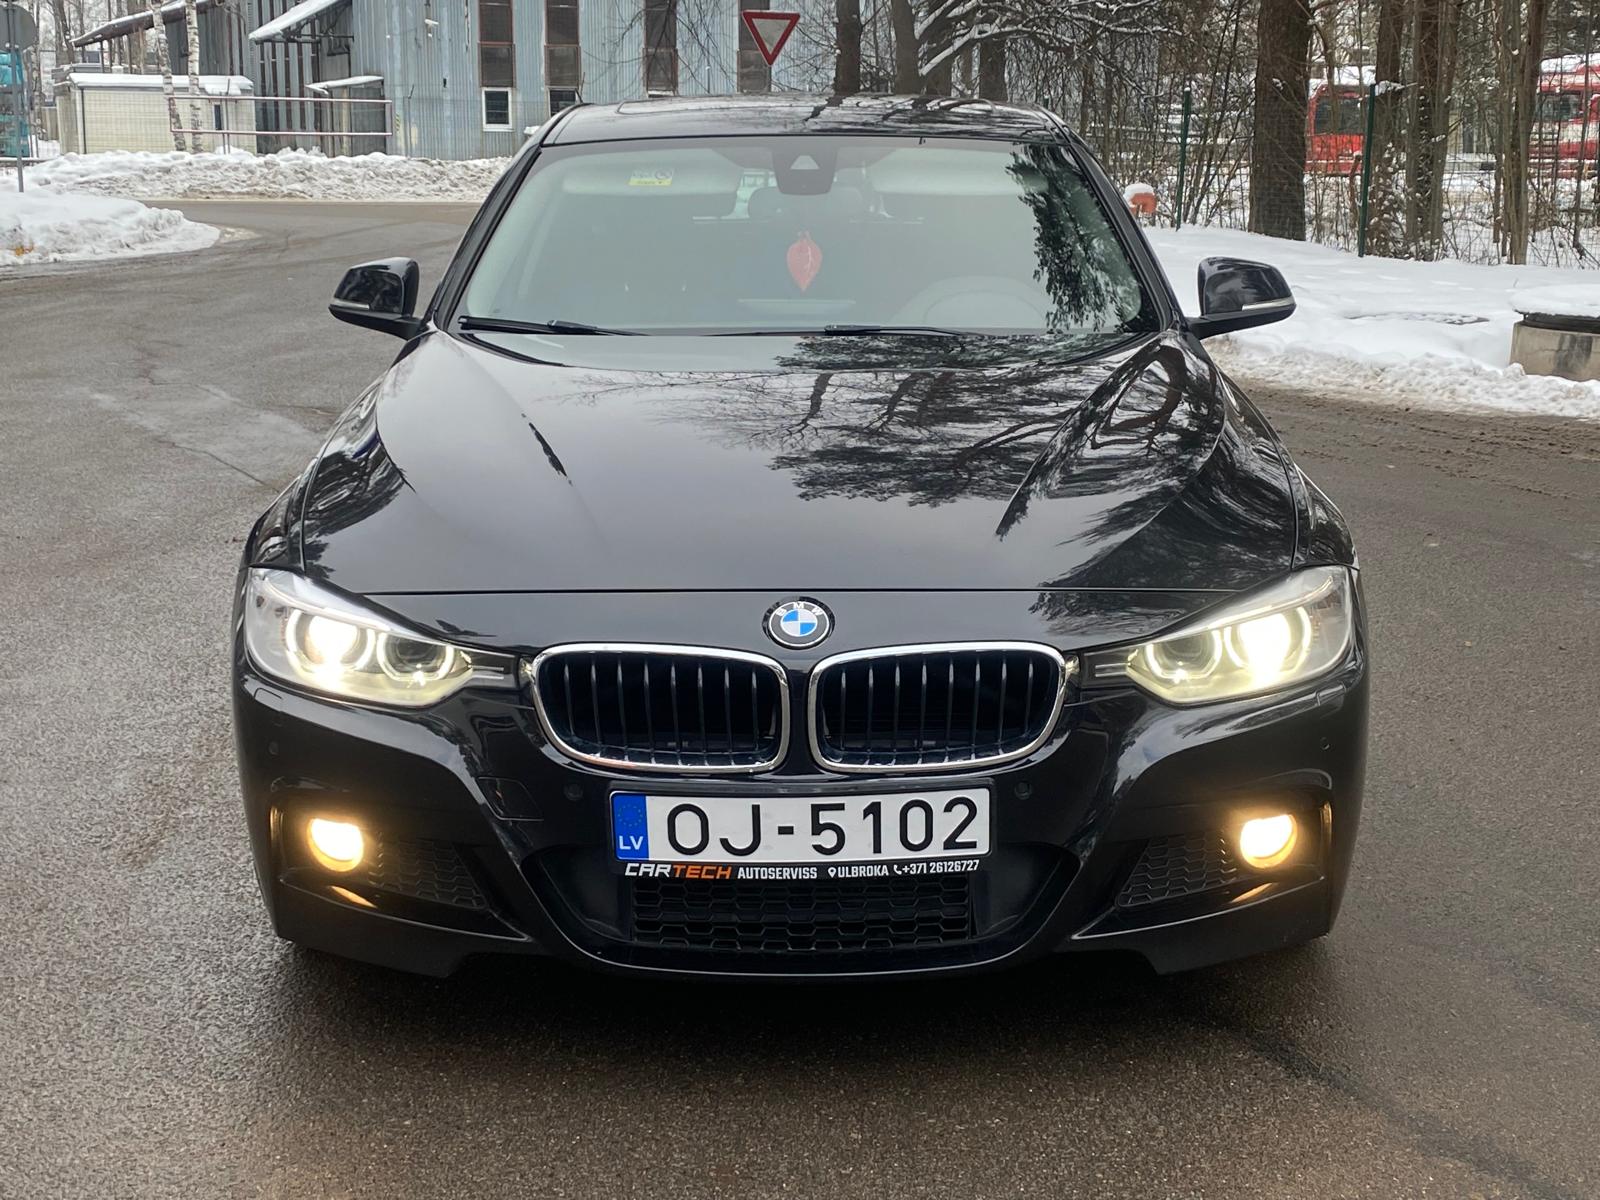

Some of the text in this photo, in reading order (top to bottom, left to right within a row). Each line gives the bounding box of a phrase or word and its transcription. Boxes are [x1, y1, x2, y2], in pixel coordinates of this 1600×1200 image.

[775, 601, 824, 617] BMW
[667, 797, 978, 856] OJ-5102
[619, 836, 643, 850] LV
[625, 860, 980, 880] CARTECH AUTOSERVISS ULBROKA +371 26126727
